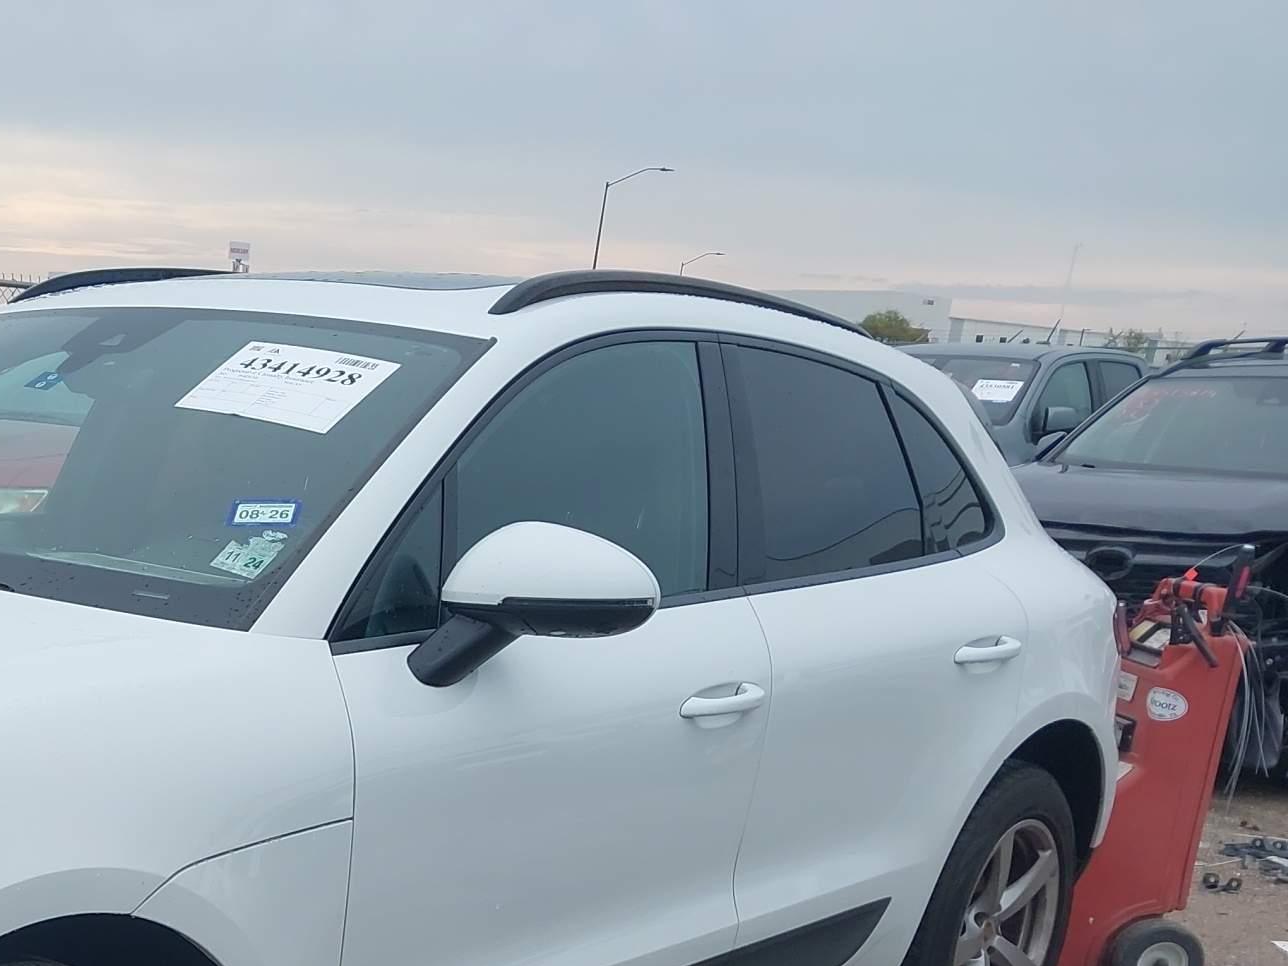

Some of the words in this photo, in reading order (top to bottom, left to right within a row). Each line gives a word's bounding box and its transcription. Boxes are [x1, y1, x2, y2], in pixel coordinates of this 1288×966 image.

[240, 357, 362, 386] 43414928
[239, 510, 259, 519] 08
[269, 510, 290, 519] 26
[225, 551, 240, 562] 11
[243, 557, 264, 570] 24
